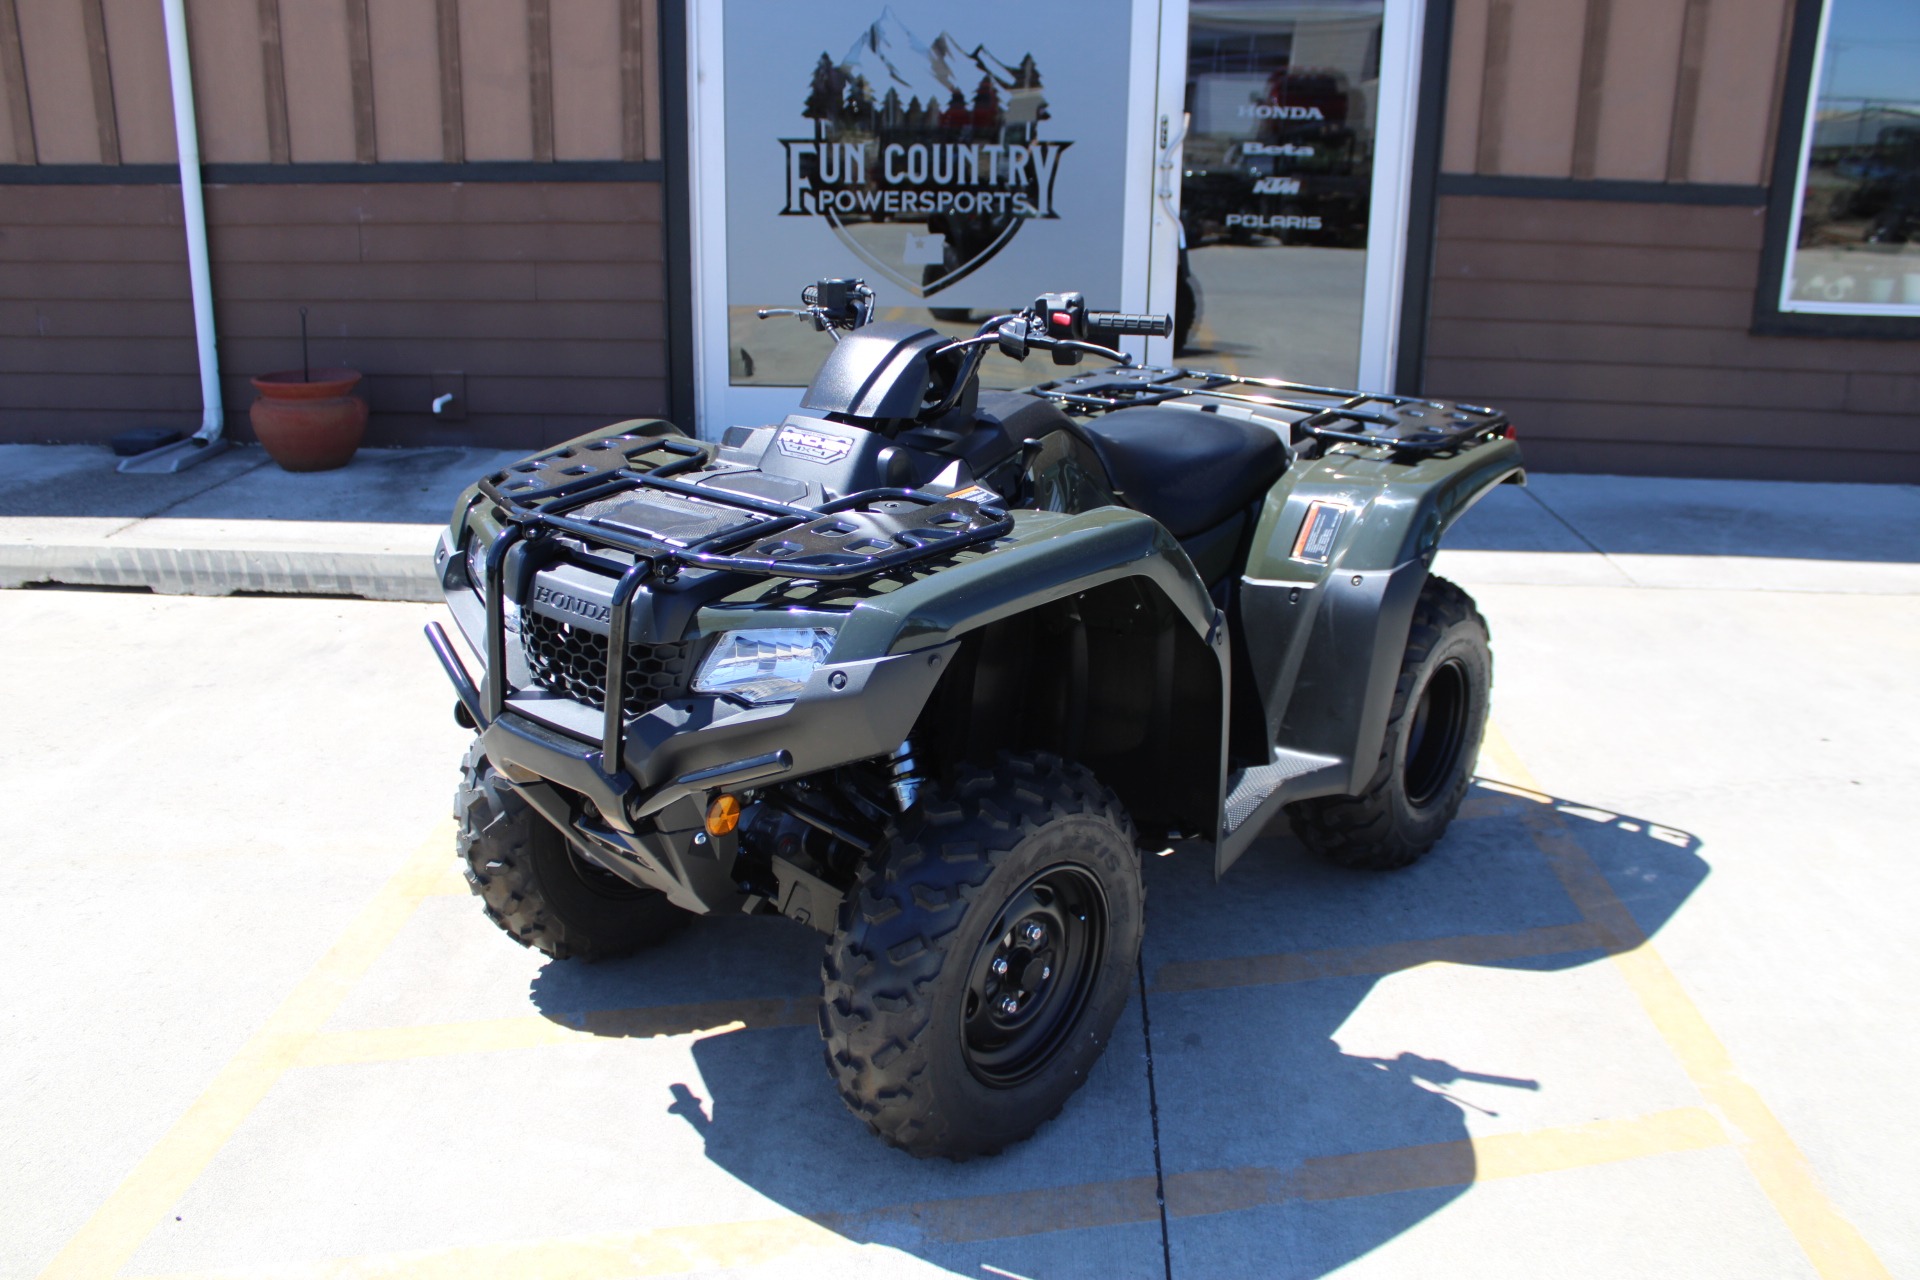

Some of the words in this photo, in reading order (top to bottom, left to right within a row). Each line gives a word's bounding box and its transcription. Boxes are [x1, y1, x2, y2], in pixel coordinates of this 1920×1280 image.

[1238, 105, 1324, 120] HONDA
[1243, 142, 1315, 157] Beta
[788, 142, 865, 212] FUN
[884, 143, 1060, 214] COUNTRY
[1252, 177, 1301, 194] KTM
[818, 190, 1029, 214] POWERSPORTS
[1226, 214, 1322, 230] POLARIS
[777, 430, 852, 455] RANCHER
[534, 585, 611, 624] HONDA
